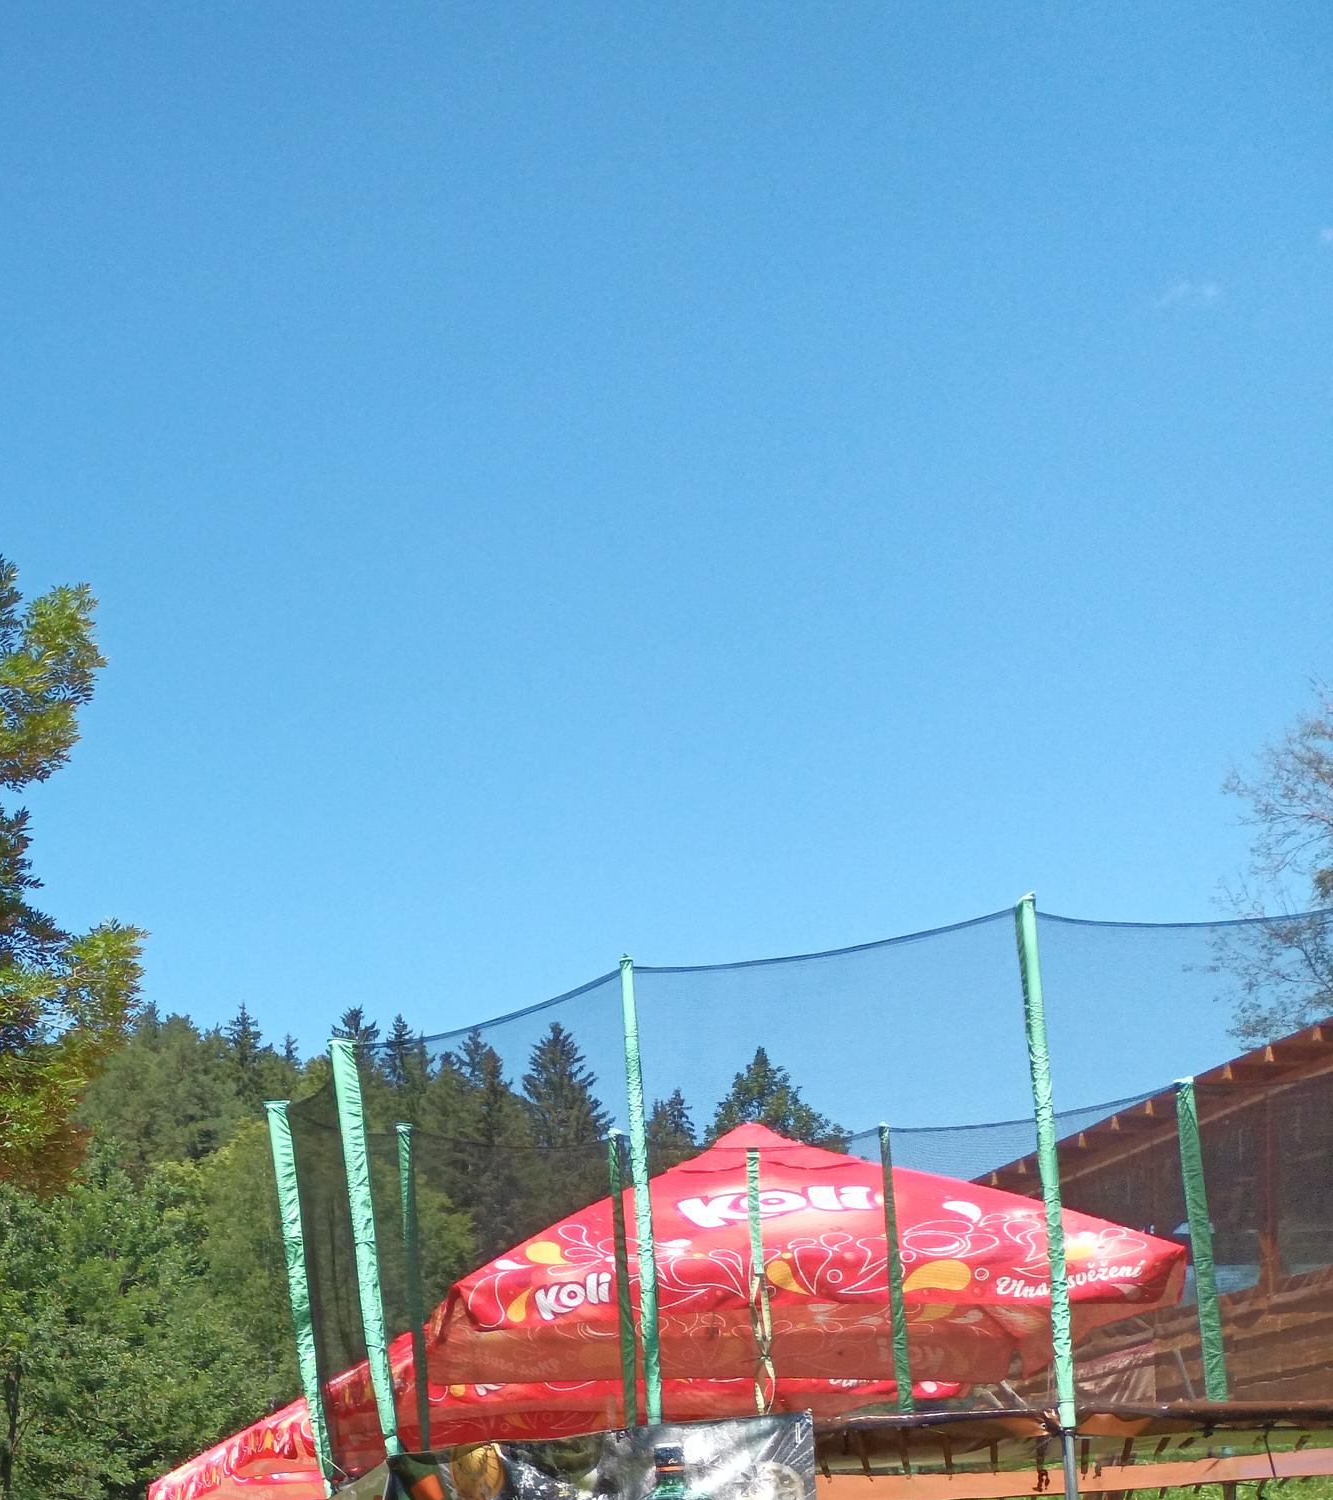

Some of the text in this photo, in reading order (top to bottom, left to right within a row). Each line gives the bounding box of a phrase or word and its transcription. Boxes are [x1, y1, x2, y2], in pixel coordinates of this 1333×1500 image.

[677, 1185, 875, 1228] Koli
[1065, 1259, 1146, 1289] svěžení
[534, 1272, 612, 1321] Koli
